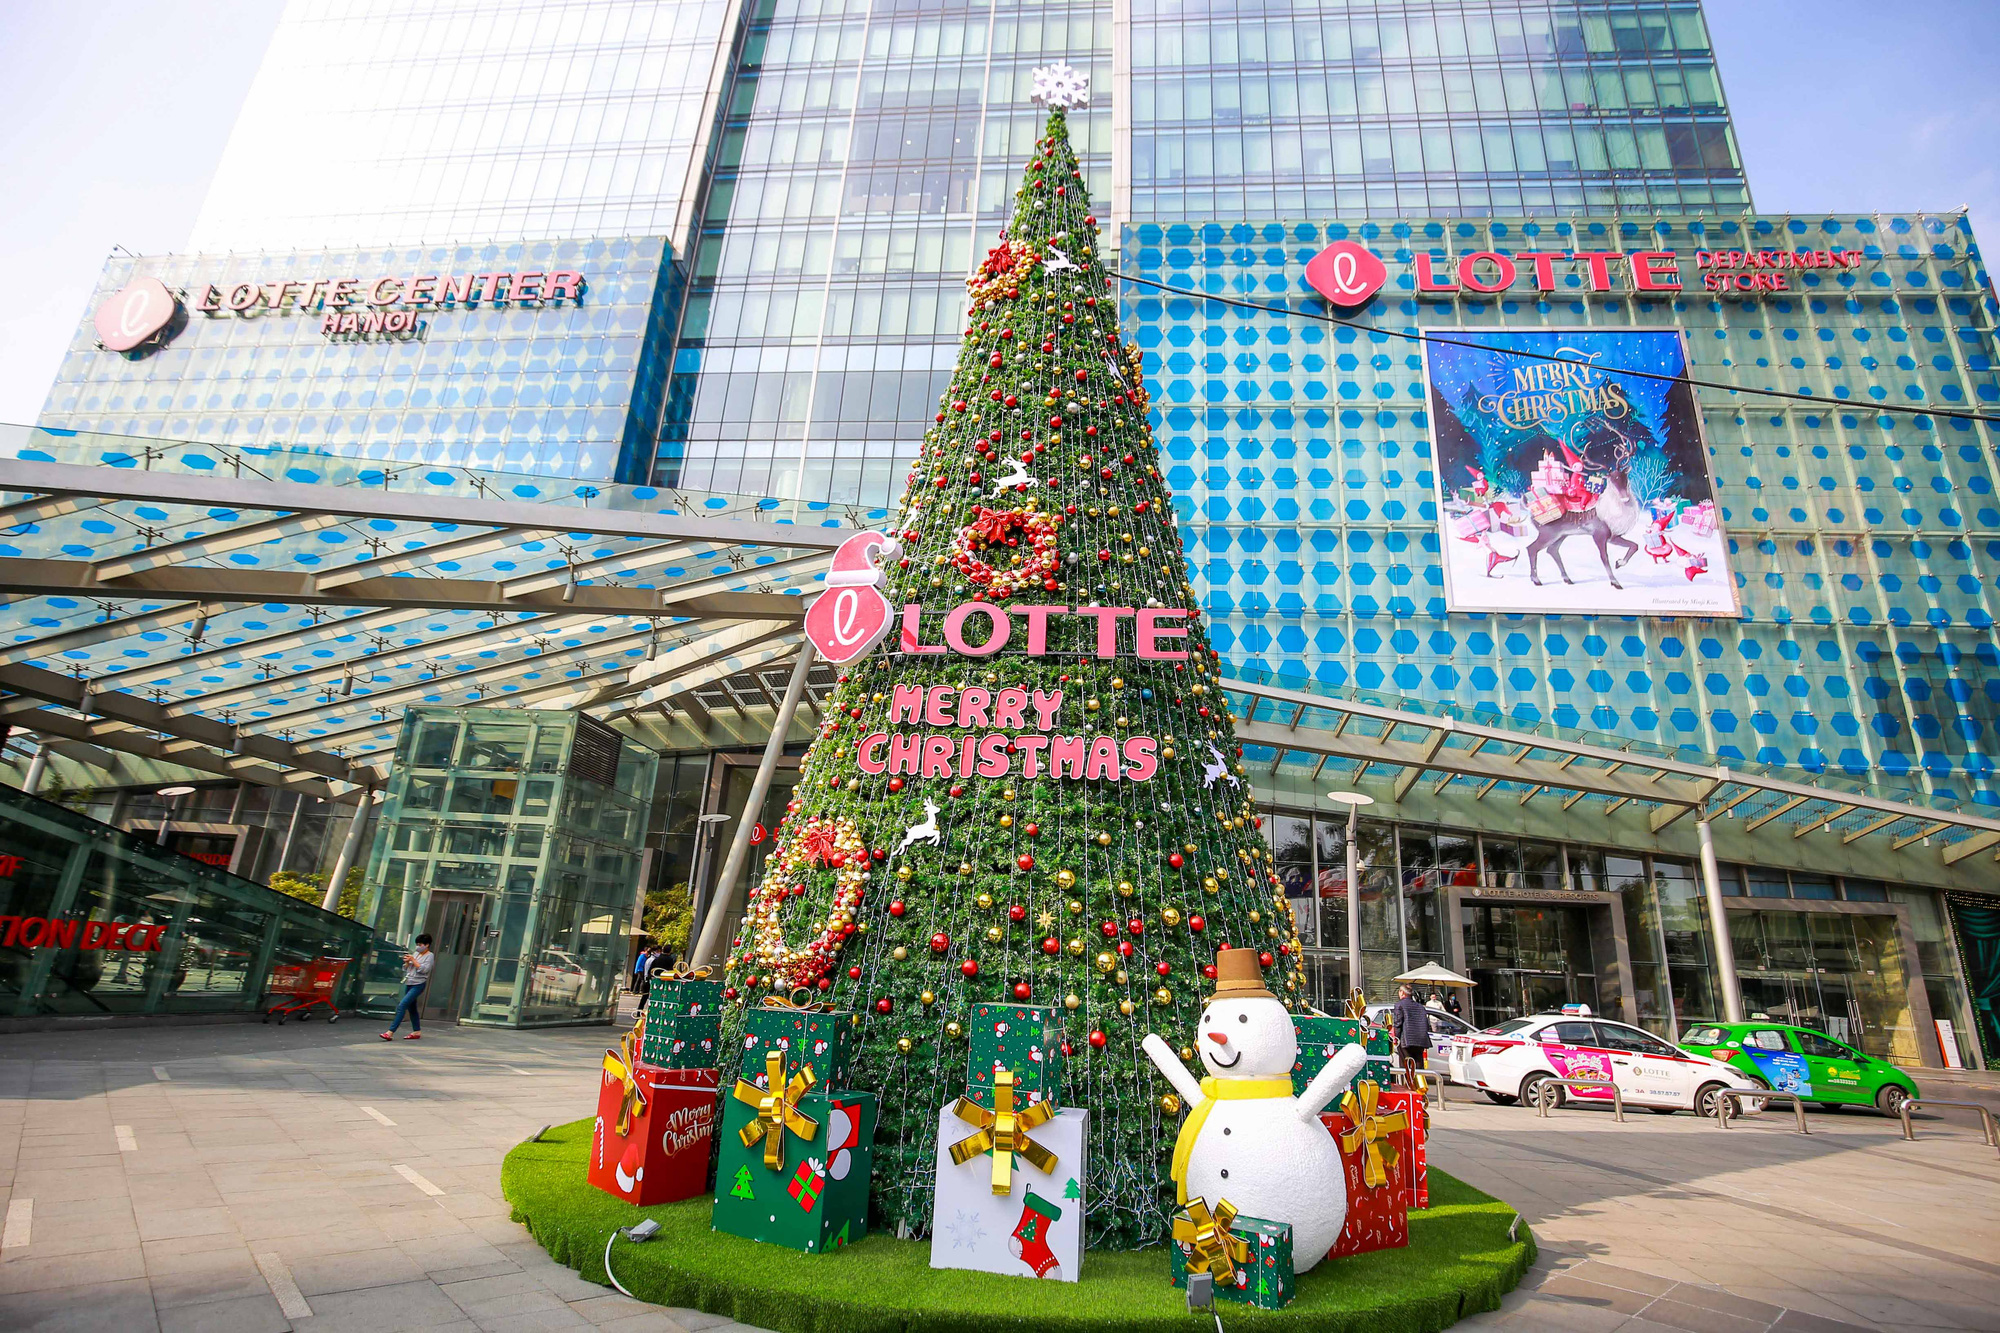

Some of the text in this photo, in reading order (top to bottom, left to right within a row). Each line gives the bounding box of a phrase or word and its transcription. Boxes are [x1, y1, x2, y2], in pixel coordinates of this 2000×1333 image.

[1413, 251, 1683, 292] LOTTE
[1695, 250, 1863, 269] DEPARTMENT
[196, 278, 359, 311] LOTTE
[367, 270, 583, 306] CENTER
[1704, 272, 1790, 291] STORE
[320, 311, 418, 334] HANOI
[1513, 347, 1602, 393] MERRY
[1478, 383, 1629, 433] CHRISTMAS
[900, 601, 1189, 660] LOTTE
[889, 684, 1064, 732] MERRY
[857, 732, 1159, 782] CHRISTMAS
[1482, 889, 1599, 901] LOTTE HOTELS & RESORTS
[80, 920, 168, 952] DECK
[1643, 1067, 1670, 1077] LOTTE
[665, 1103, 714, 1131] Merry
